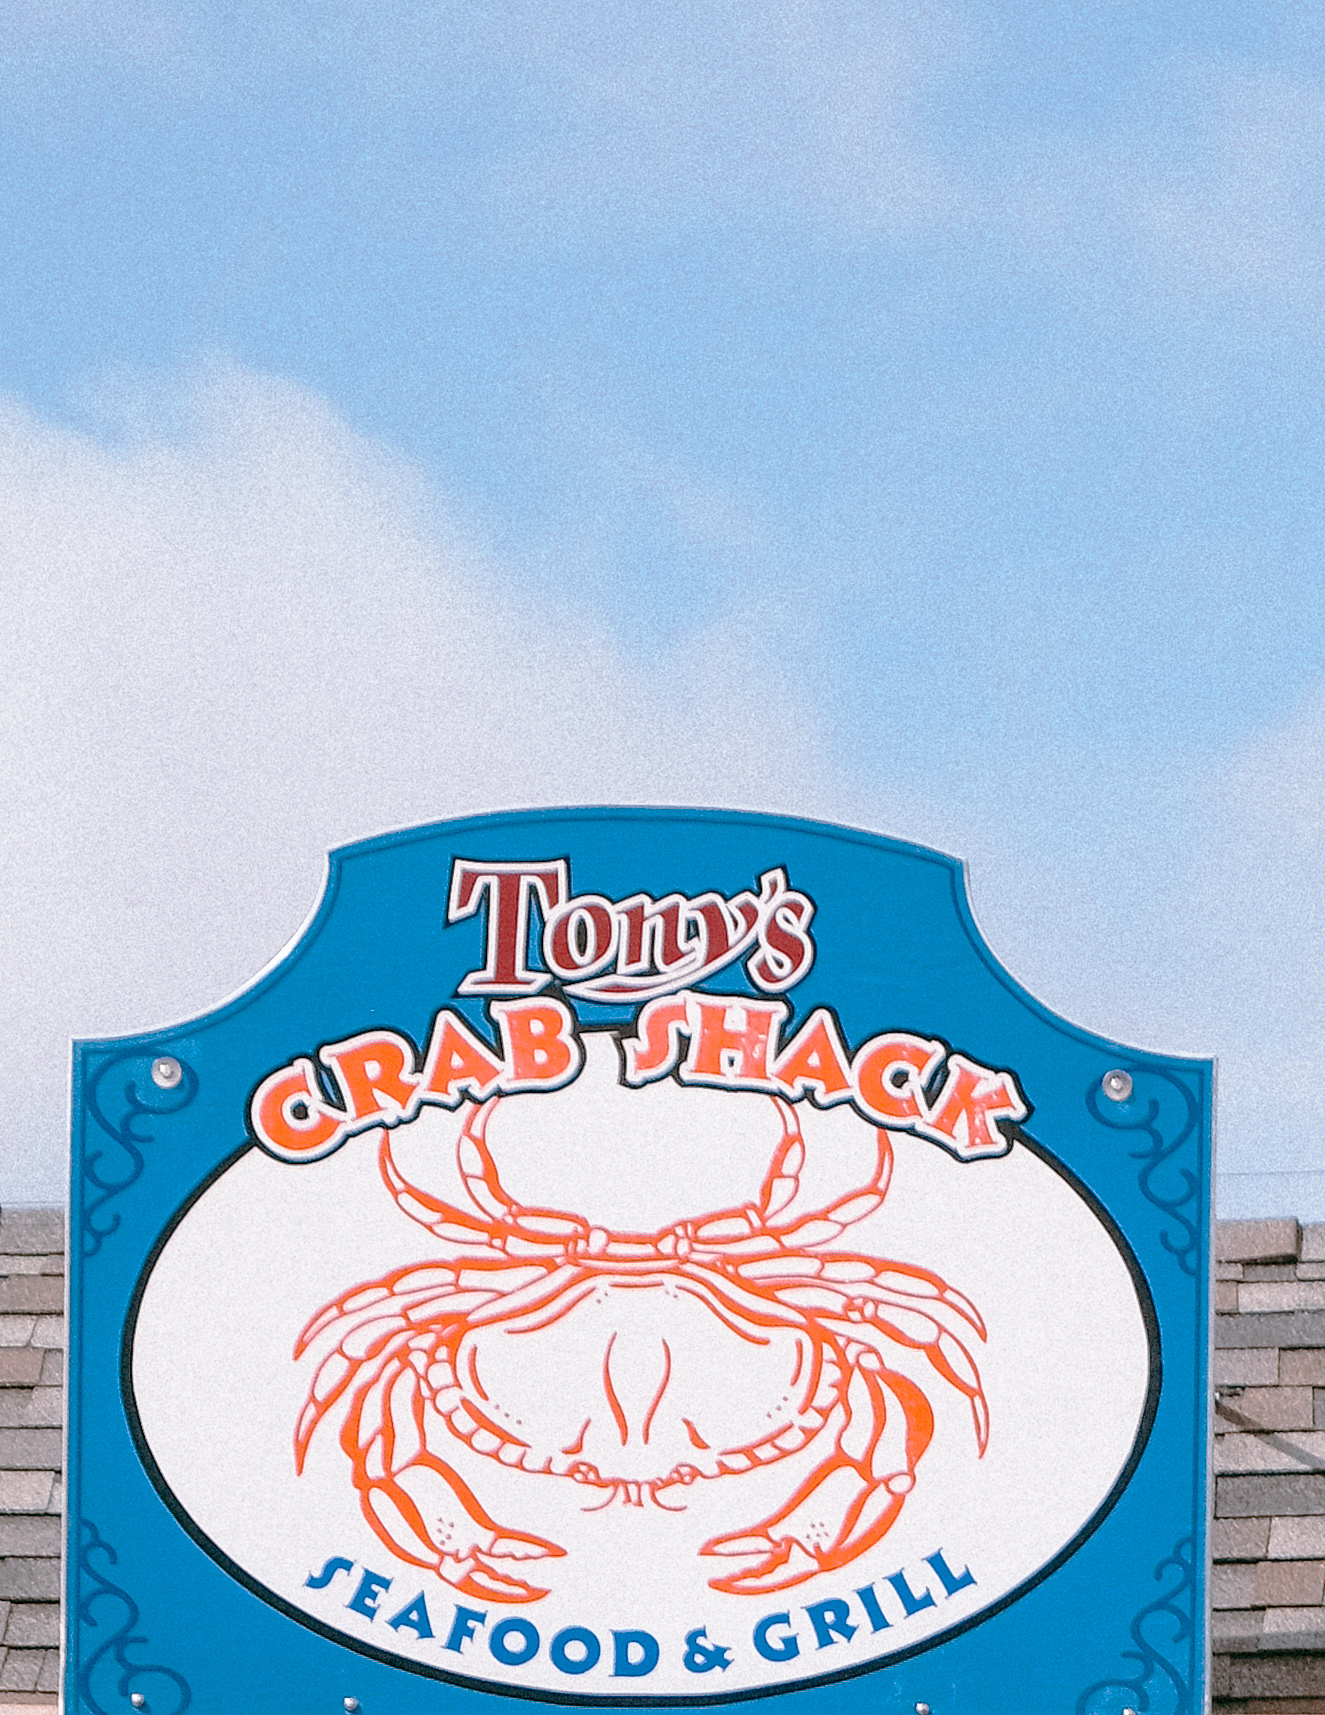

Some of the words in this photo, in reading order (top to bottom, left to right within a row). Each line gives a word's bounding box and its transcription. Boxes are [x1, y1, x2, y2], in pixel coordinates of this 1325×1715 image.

[449, 857, 817, 1003] Tony's
[252, 997, 584, 1160] CRAB
[622, 990, 1034, 1160] SHACK
[304, 1556, 661, 1678] SEAFOOD
[683, 1627, 733, 1674] &
[753, 1549, 979, 1663] GRILL
